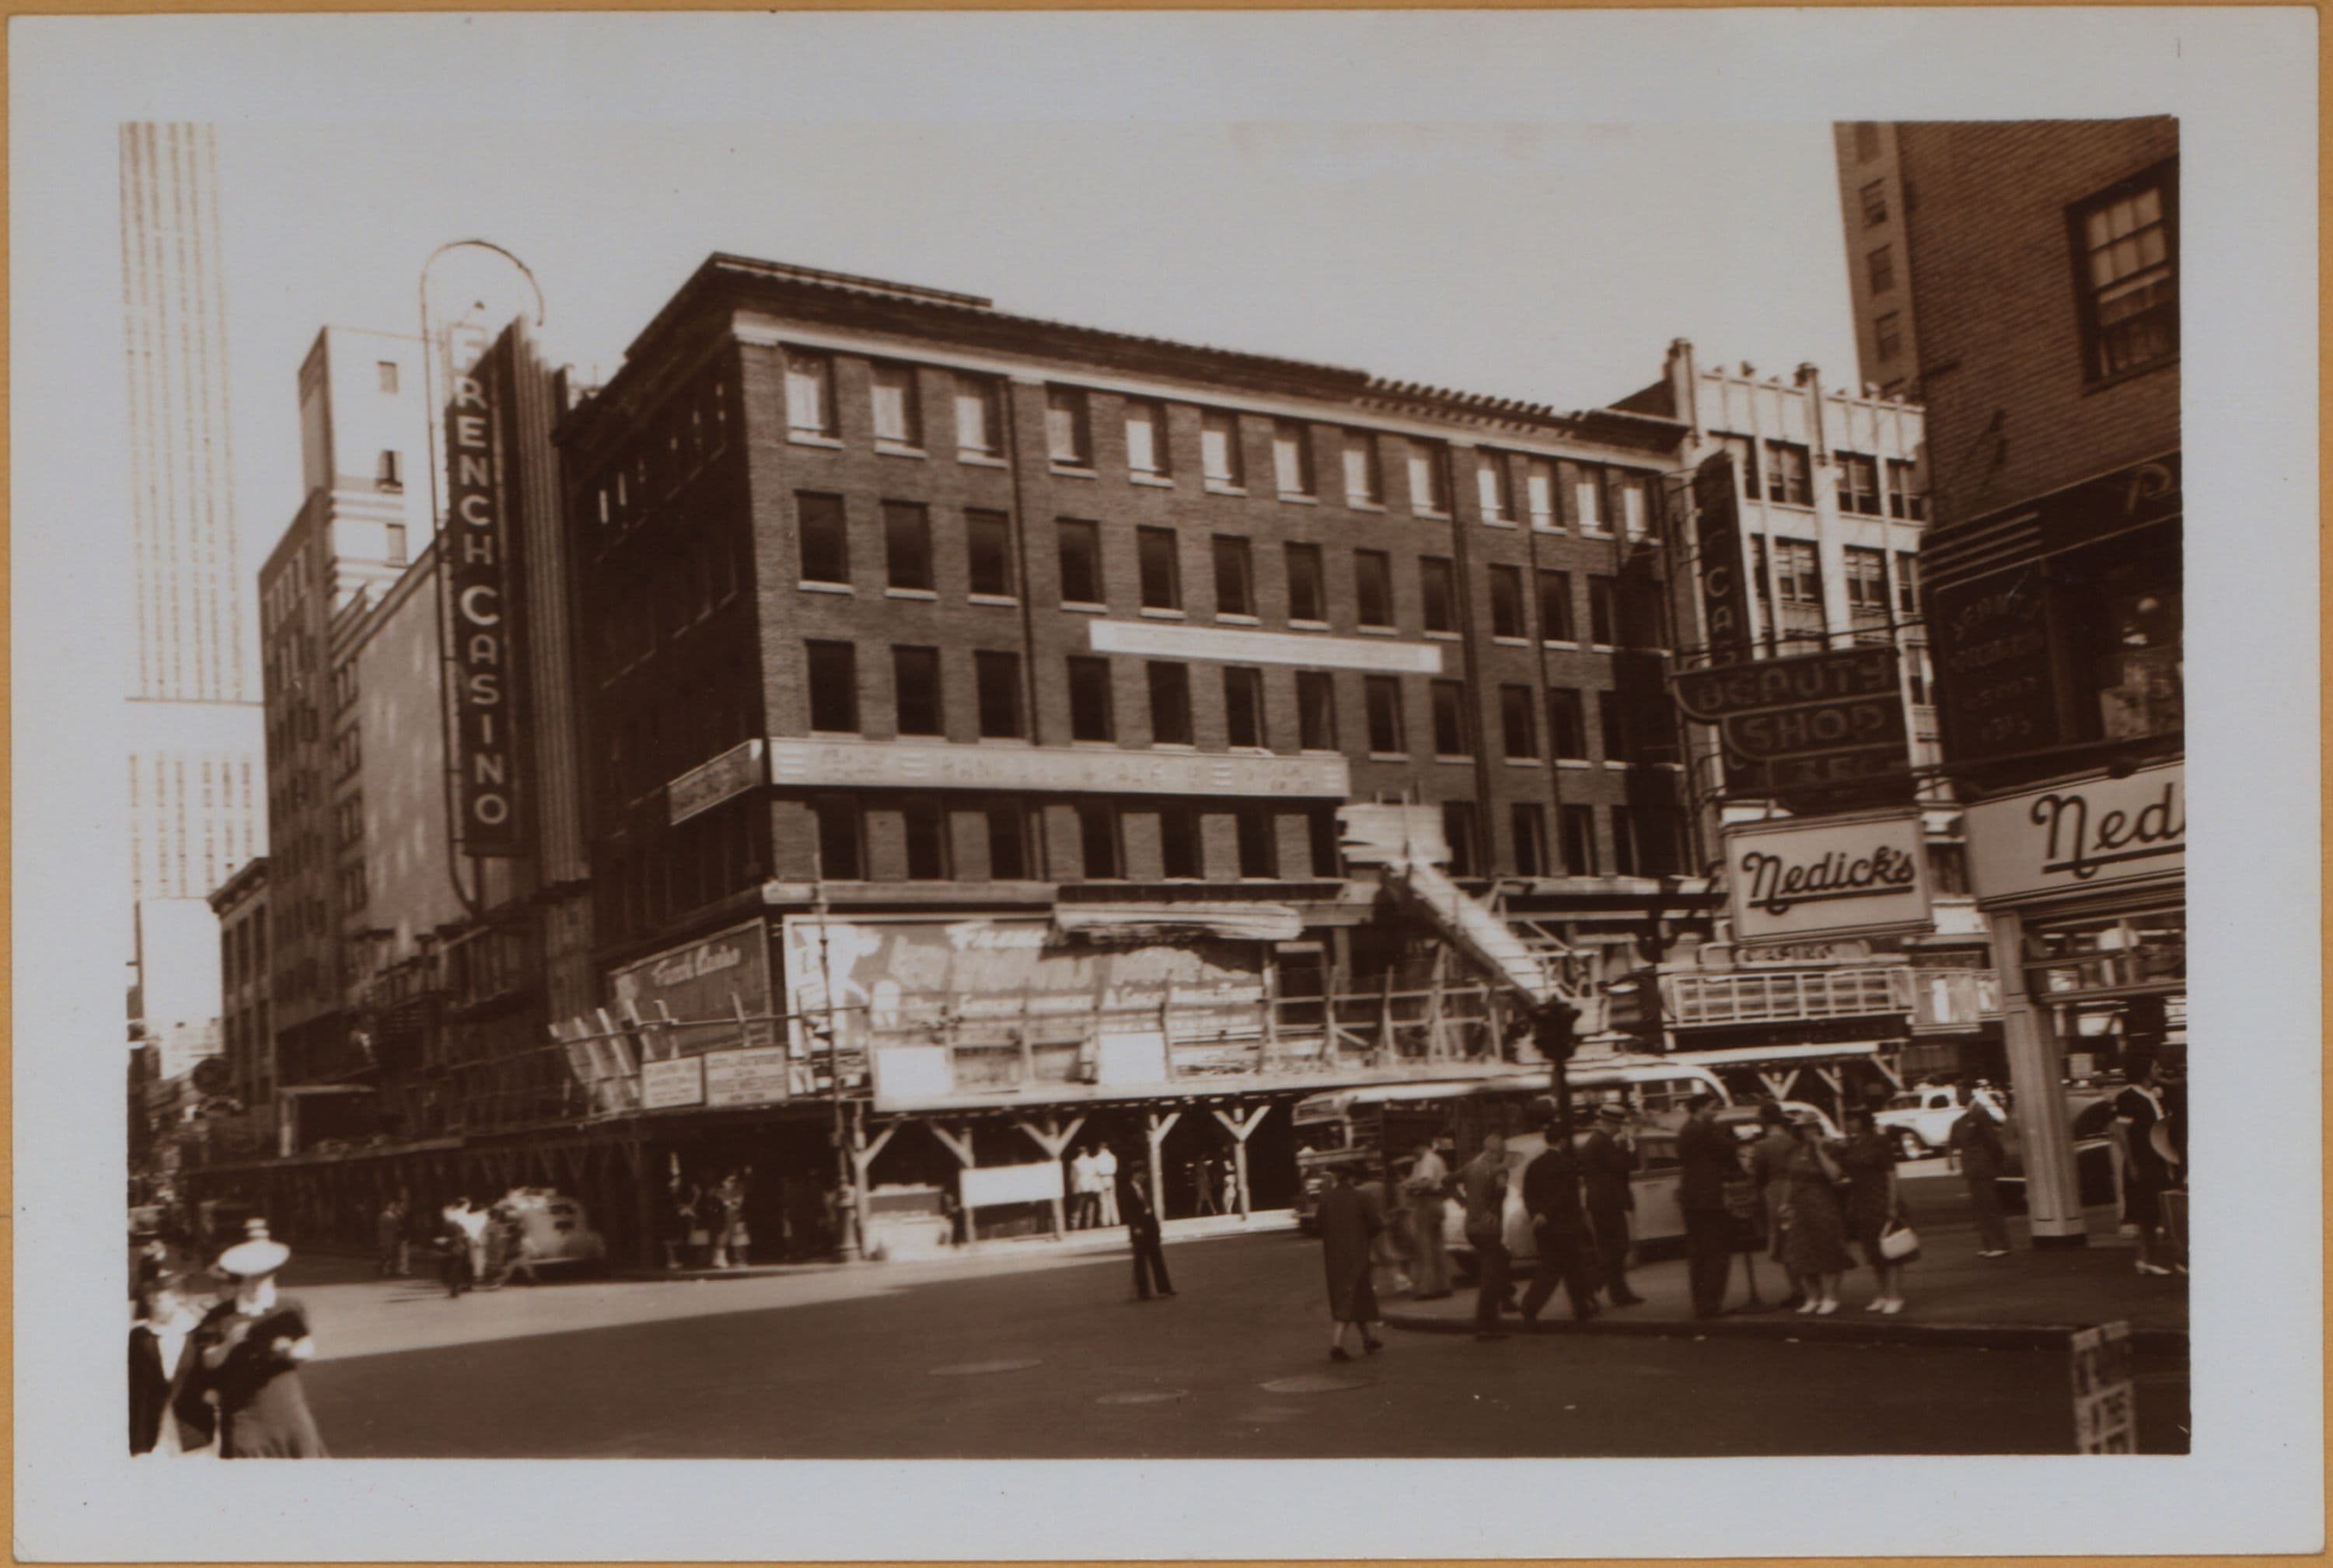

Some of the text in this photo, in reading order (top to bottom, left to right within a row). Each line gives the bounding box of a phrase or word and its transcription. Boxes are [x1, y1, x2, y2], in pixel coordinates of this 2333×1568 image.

[452, 323, 493, 564] FRENCH
[461, 585, 509, 826] CASINO
[1698, 655, 1891, 711] BEAUTY
[1743, 704, 1886, 750] SHOP
[2031, 782, 2186, 879] Ned
[1741, 846, 1916, 916] Nedick's
